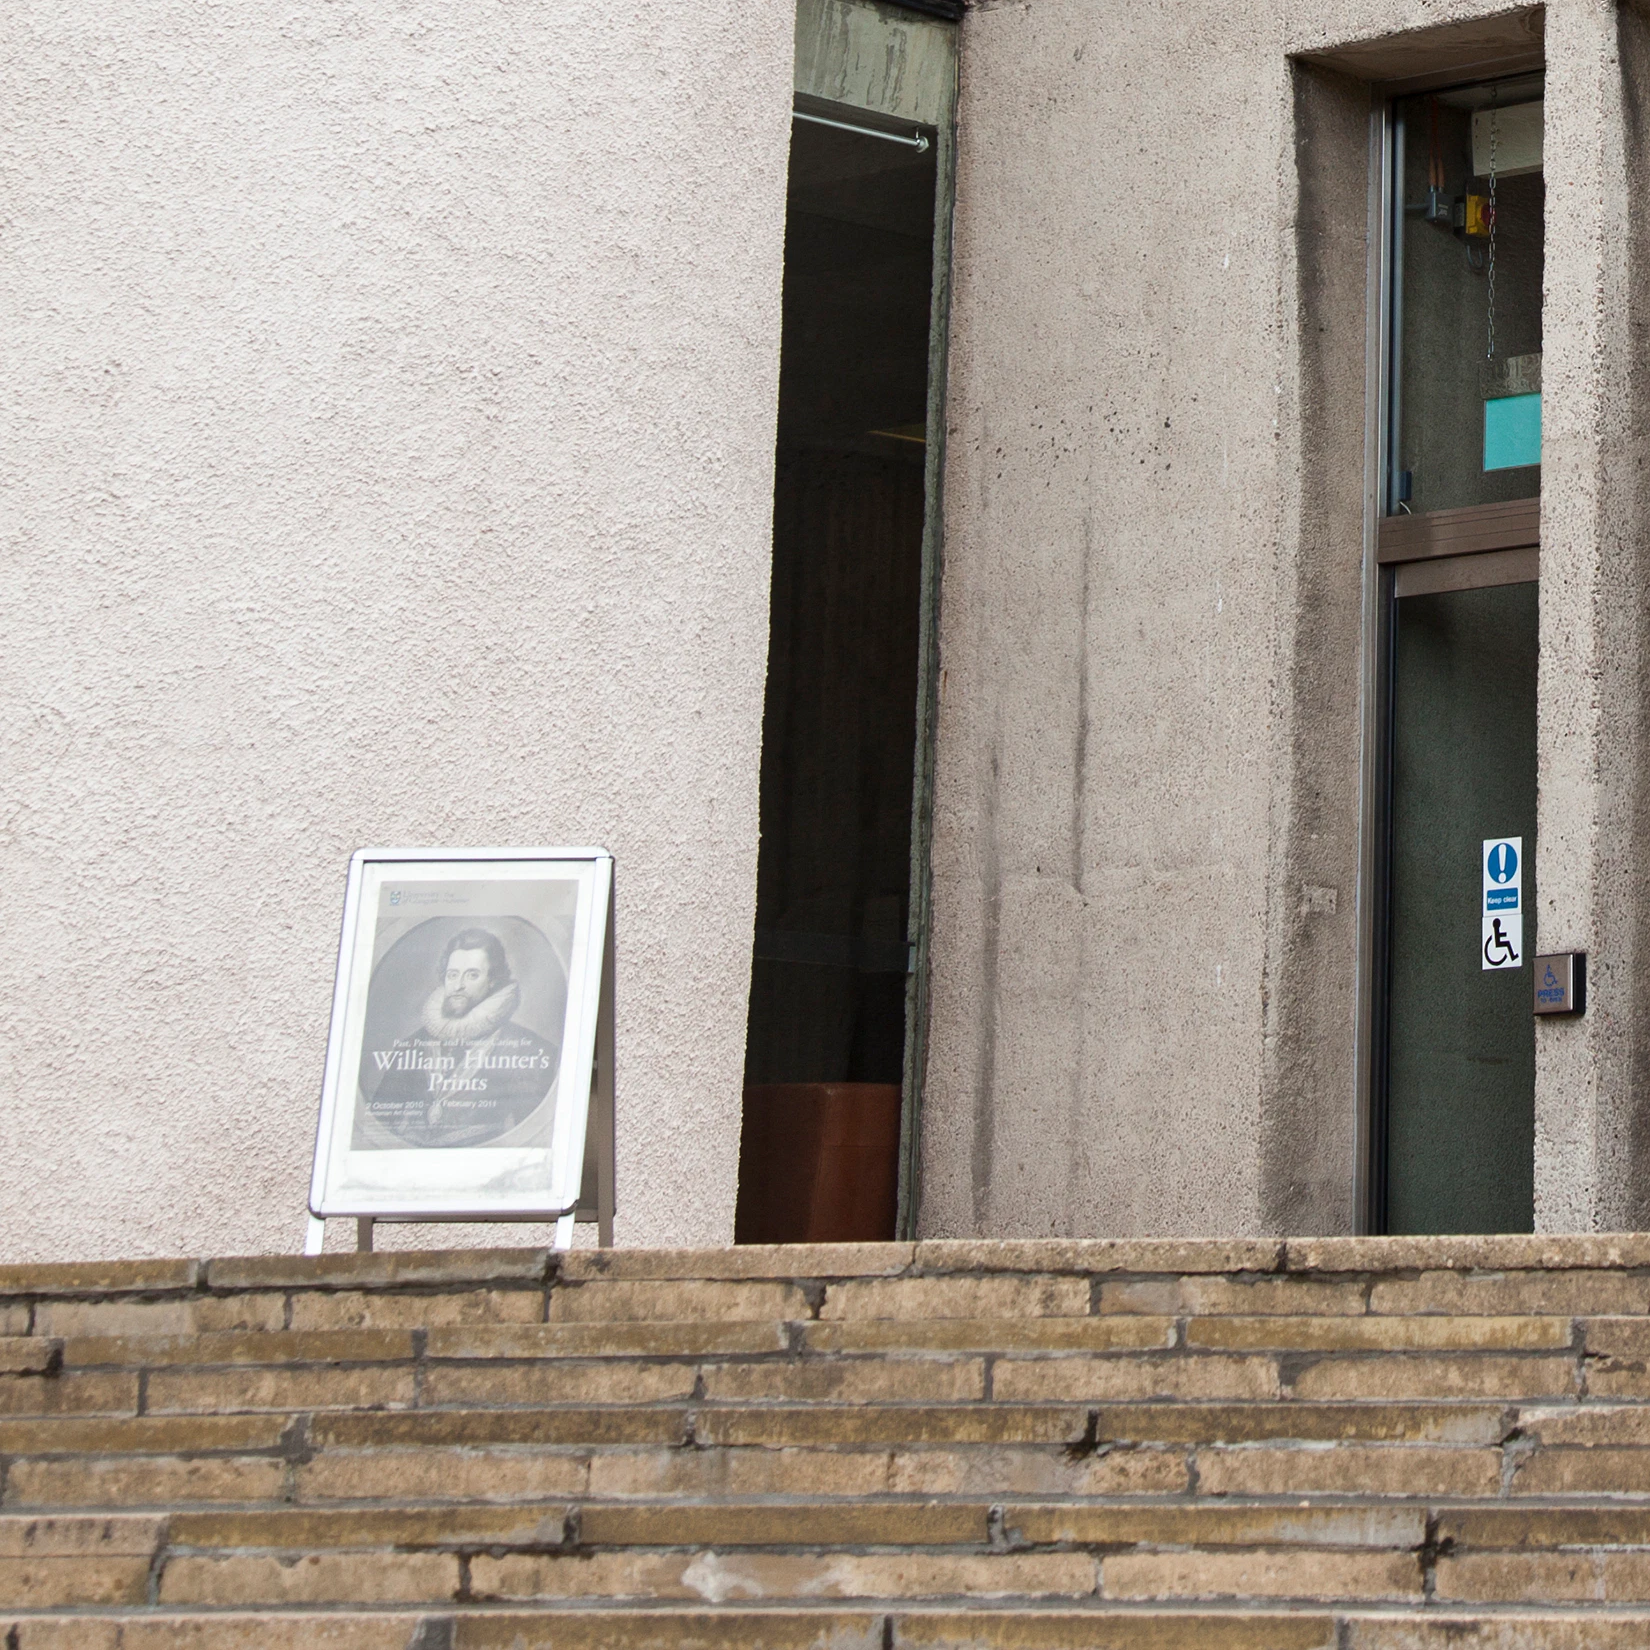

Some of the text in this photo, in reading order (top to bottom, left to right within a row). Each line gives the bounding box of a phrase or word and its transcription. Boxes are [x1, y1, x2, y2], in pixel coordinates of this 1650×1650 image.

[1487, 897, 1502, 905] Keep
[1538, 987, 1565, 998] PRESS
[444, 1038, 458, 1046] and
[520, 1038, 532, 1046] for
[373, 1049, 549, 1070] William Hunter's
[428, 1073, 488, 1092] Prints
[372, 1101, 403, 1110] October
[405, 1101, 424, 1109] 2010
[442, 1100, 476, 1108] February
